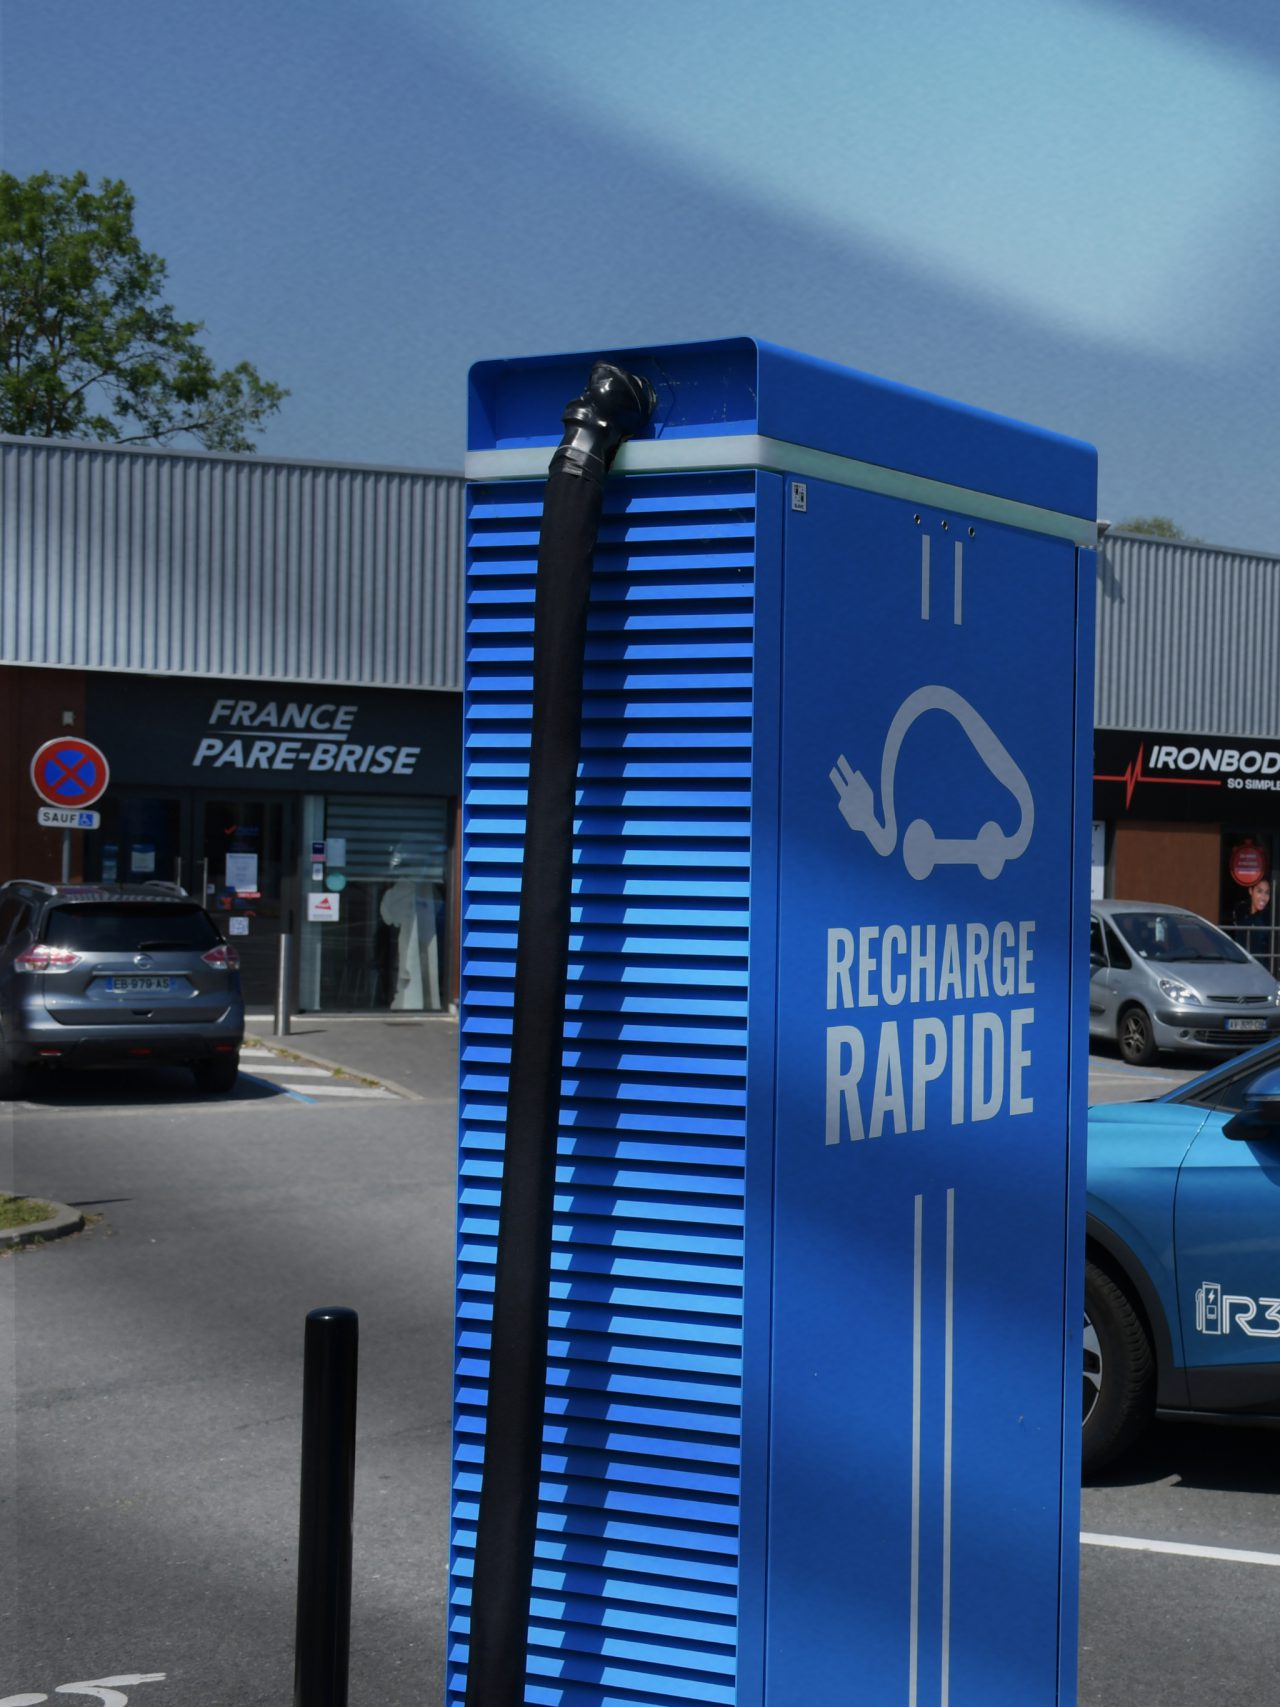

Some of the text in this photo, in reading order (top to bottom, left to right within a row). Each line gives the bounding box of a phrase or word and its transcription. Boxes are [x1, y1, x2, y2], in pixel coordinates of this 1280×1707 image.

[208, 699, 358, 731] FRANCE
[192, 737, 421, 775] PARE-BRISE
[1227, 777, 1244, 789] SO
[43, 811, 77, 824] SAUF
[826, 920, 1036, 1010] RECHARGE
[825, 1007, 1035, 1146] RAPIDE
